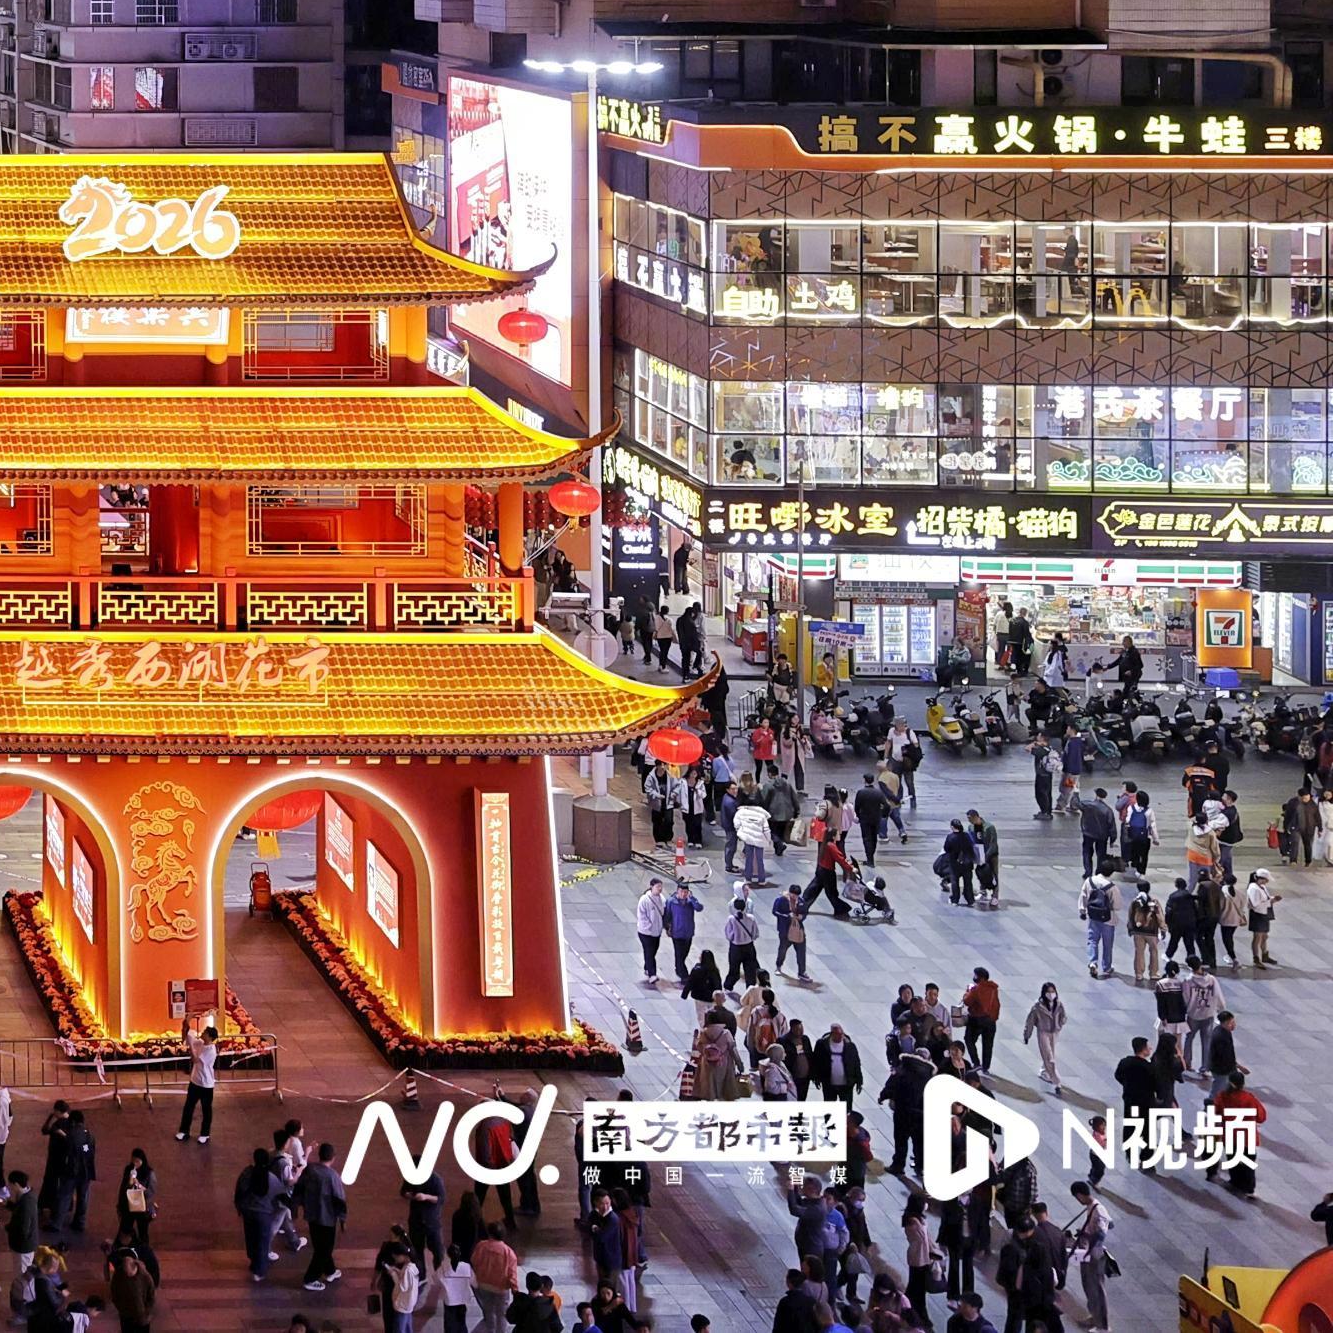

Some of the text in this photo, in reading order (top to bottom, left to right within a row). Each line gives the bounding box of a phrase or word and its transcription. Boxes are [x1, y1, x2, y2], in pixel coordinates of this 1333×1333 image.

[818, 114, 1323, 155] 搞不赢火锅·牛蛙 三楼
[58, 175, 241, 262] 2026
[723, 285, 780, 316] 自助
[1054, 386, 1242, 421] 港式茶餐厅
[13, 635, 332, 697] 越秀西湖花市
